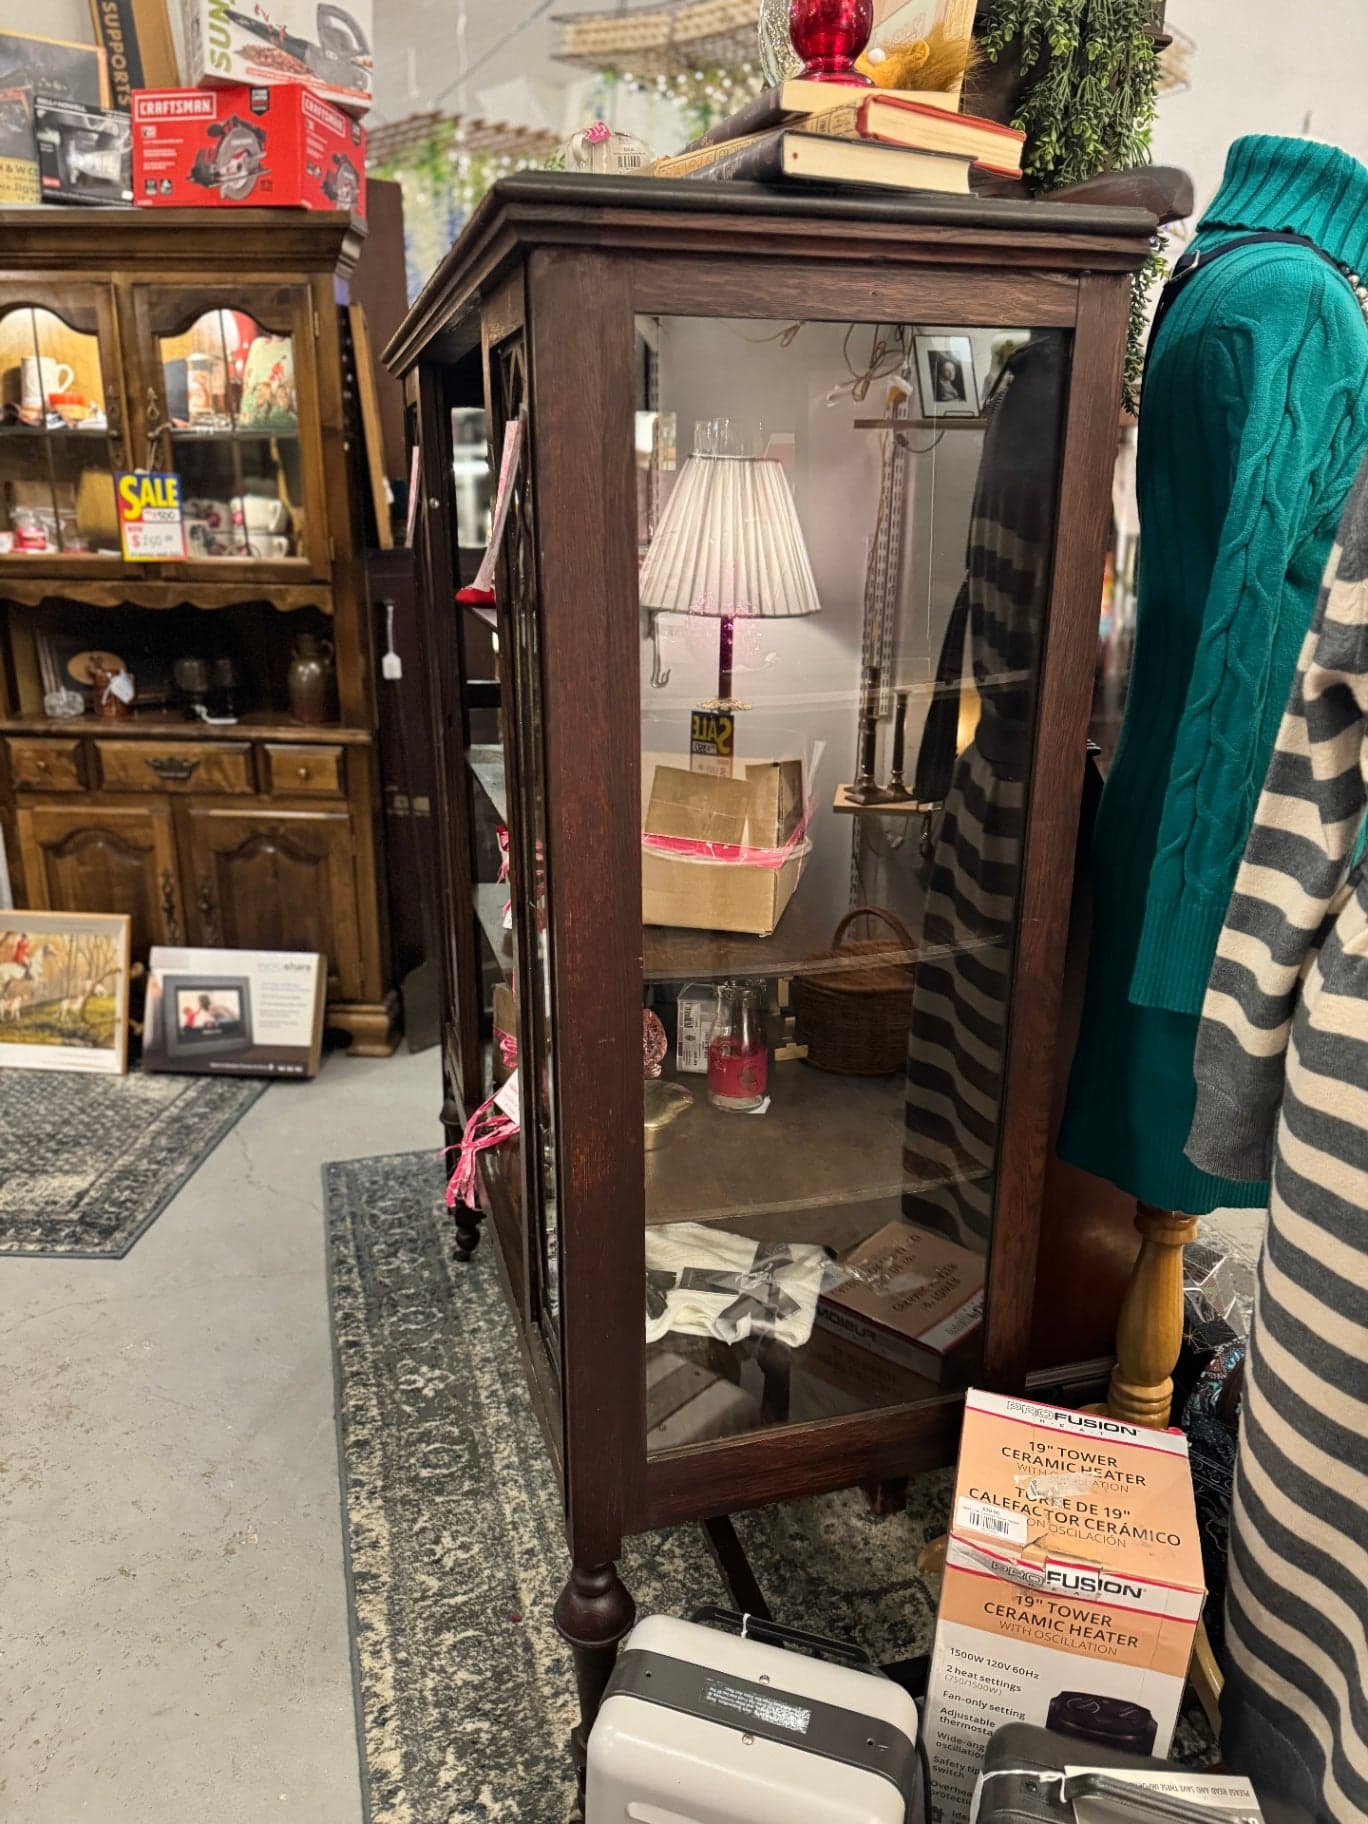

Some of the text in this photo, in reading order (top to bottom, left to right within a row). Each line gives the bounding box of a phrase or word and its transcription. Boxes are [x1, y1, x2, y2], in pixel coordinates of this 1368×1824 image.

[102, 1, 131, 105] SUPPORTS
[139, 99, 211, 116] CRAFTSMAN
[119, 475, 179, 520] SALE
[1001, 1446, 1077, 1473] CERAMIC
[1080, 1464, 1147, 1486] HEATER
[1028, 1441, 1118, 1468] 19" TOWER
[1016, 1463, 1048, 1477] WITH
[969, 1487, 1081, 1528] CALEFACTOR
[1085, 1517, 1182, 1547] CERÁMICO
[1076, 1501, 1099, 1516] DE
[1104, 1507, 1131, 1520] 19"
[1050, 1523, 1127, 1549] OSCILACIÓN
[1016, 1595, 1113, 1628] 19" TOWER
[984, 1602, 1139, 1649] CERAMIC HEATER
[1000, 1620, 1118, 1656] WITH OSCILLATION
[951, 1647, 1040, 1680] 1500W 120V 60Hz
[946, 1664, 1022, 1692] 2 heat settings
[940, 1707, 995, 1728] Adjustable
[943, 1690, 1026, 1720] Fan-only setting
[940, 1716, 993, 1736] thermosta
[937, 1731, 985, 1752] Wide-ang
[932, 1765, 965, 1778] switch
[933, 1755, 966, 1773] Safety
[931, 1781, 973, 1797] Overhea
[1195, 1786, 1209, 1796] AND
